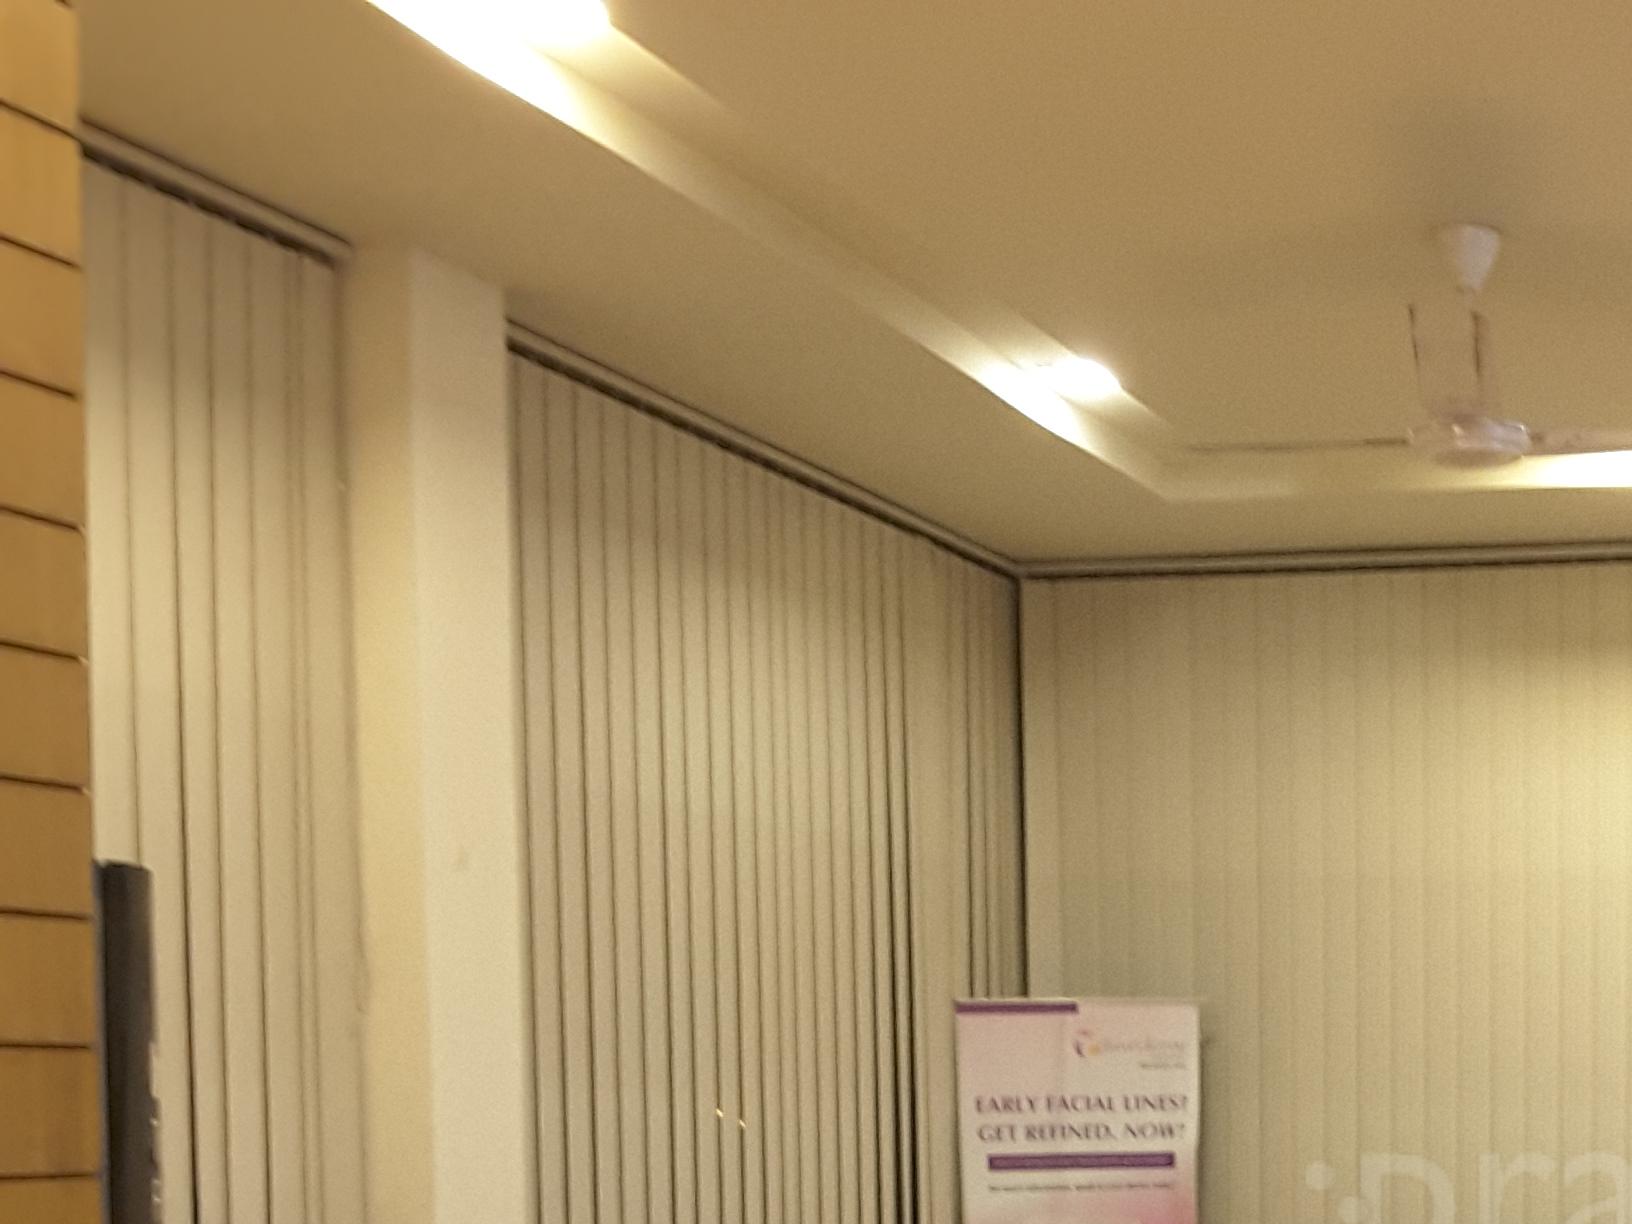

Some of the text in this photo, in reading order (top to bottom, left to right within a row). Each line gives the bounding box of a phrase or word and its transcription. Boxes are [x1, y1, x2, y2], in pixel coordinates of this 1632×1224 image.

[974, 1095, 1037, 1114] EARLY
[1046, 1095, 1116, 1113] FACIAL
[978, 1123, 1017, 1142] GET
